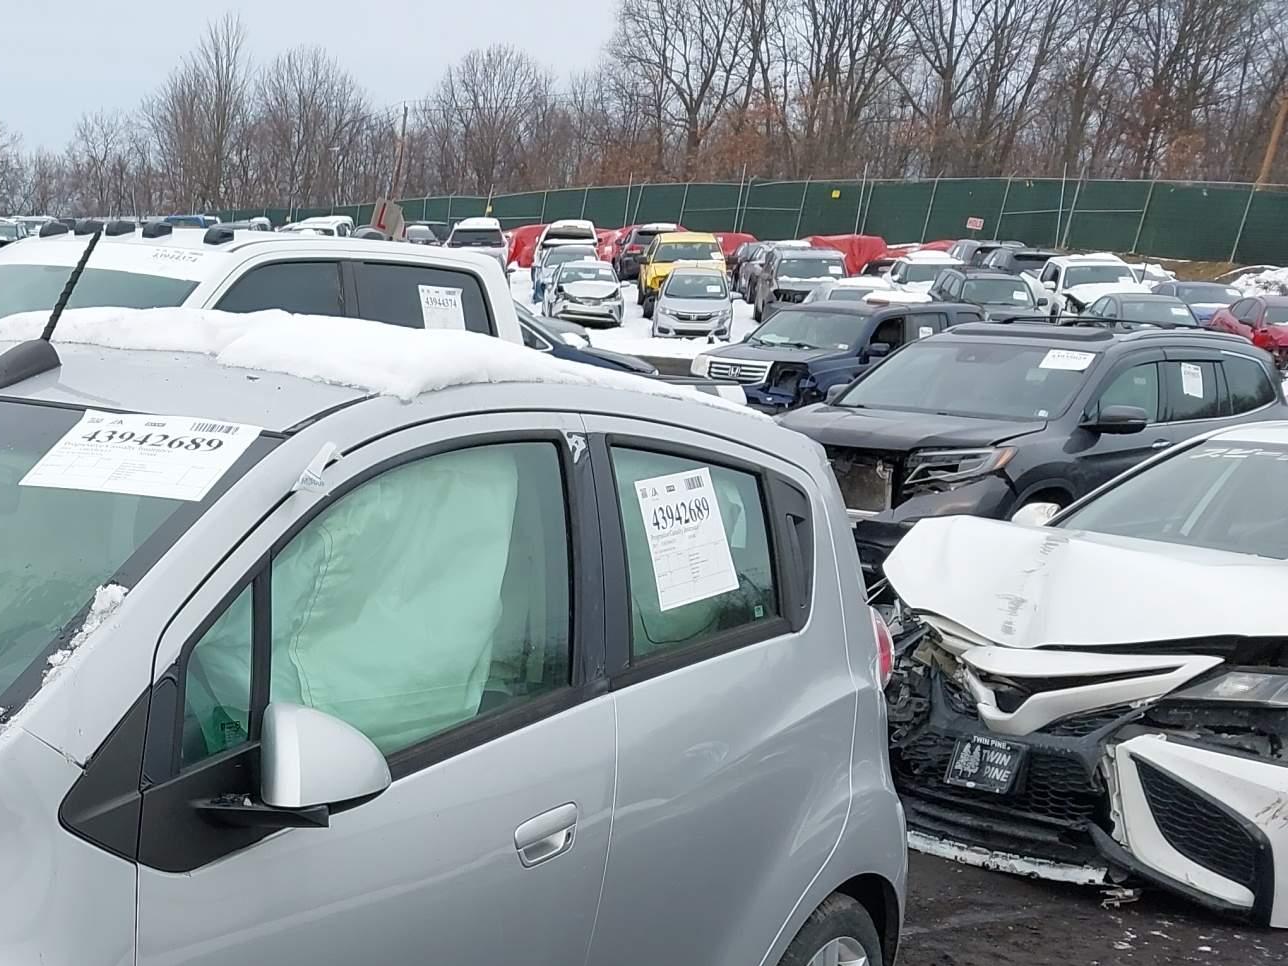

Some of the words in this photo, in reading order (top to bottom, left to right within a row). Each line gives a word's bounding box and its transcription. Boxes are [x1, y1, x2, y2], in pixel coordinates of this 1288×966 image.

[81, 428, 225, 453] 43942689
[652, 496, 711, 531] 43942689
[973, 735, 990, 746] TWIN
[990, 739, 1007, 749] PINE
[981, 749, 1012, 766] TWIN
[983, 765, 1012, 782] PINE
